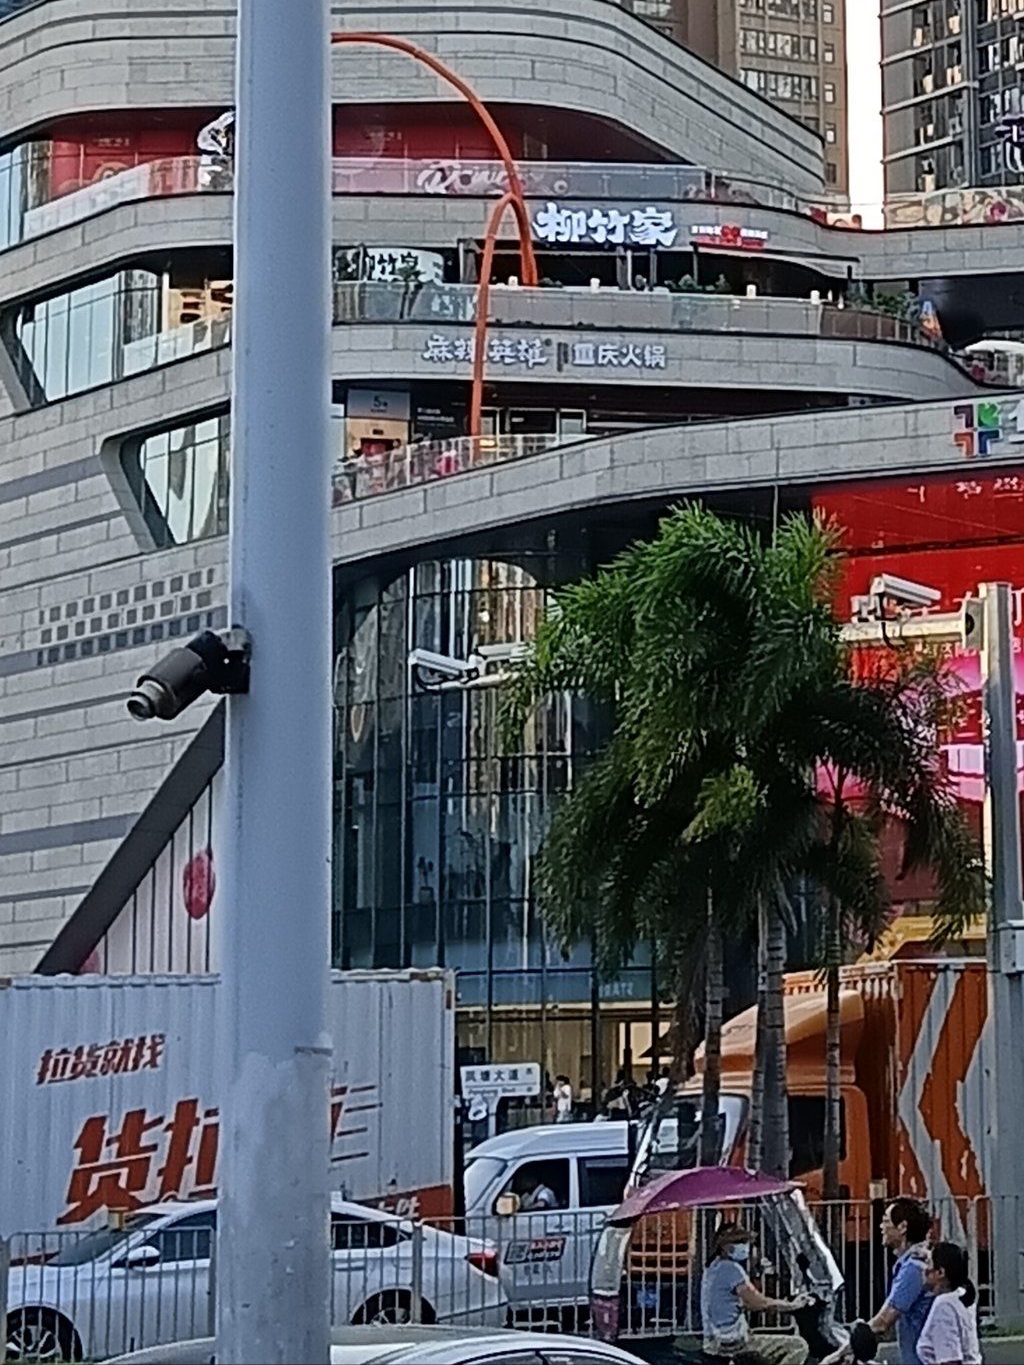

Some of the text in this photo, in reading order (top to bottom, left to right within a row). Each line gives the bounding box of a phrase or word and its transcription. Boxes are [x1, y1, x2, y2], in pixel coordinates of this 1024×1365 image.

[533, 201, 677, 247] 柳竹家
[573, 343, 666, 369] 重庆火锅
[36, 1034, 166, 1085] 拉货就找
